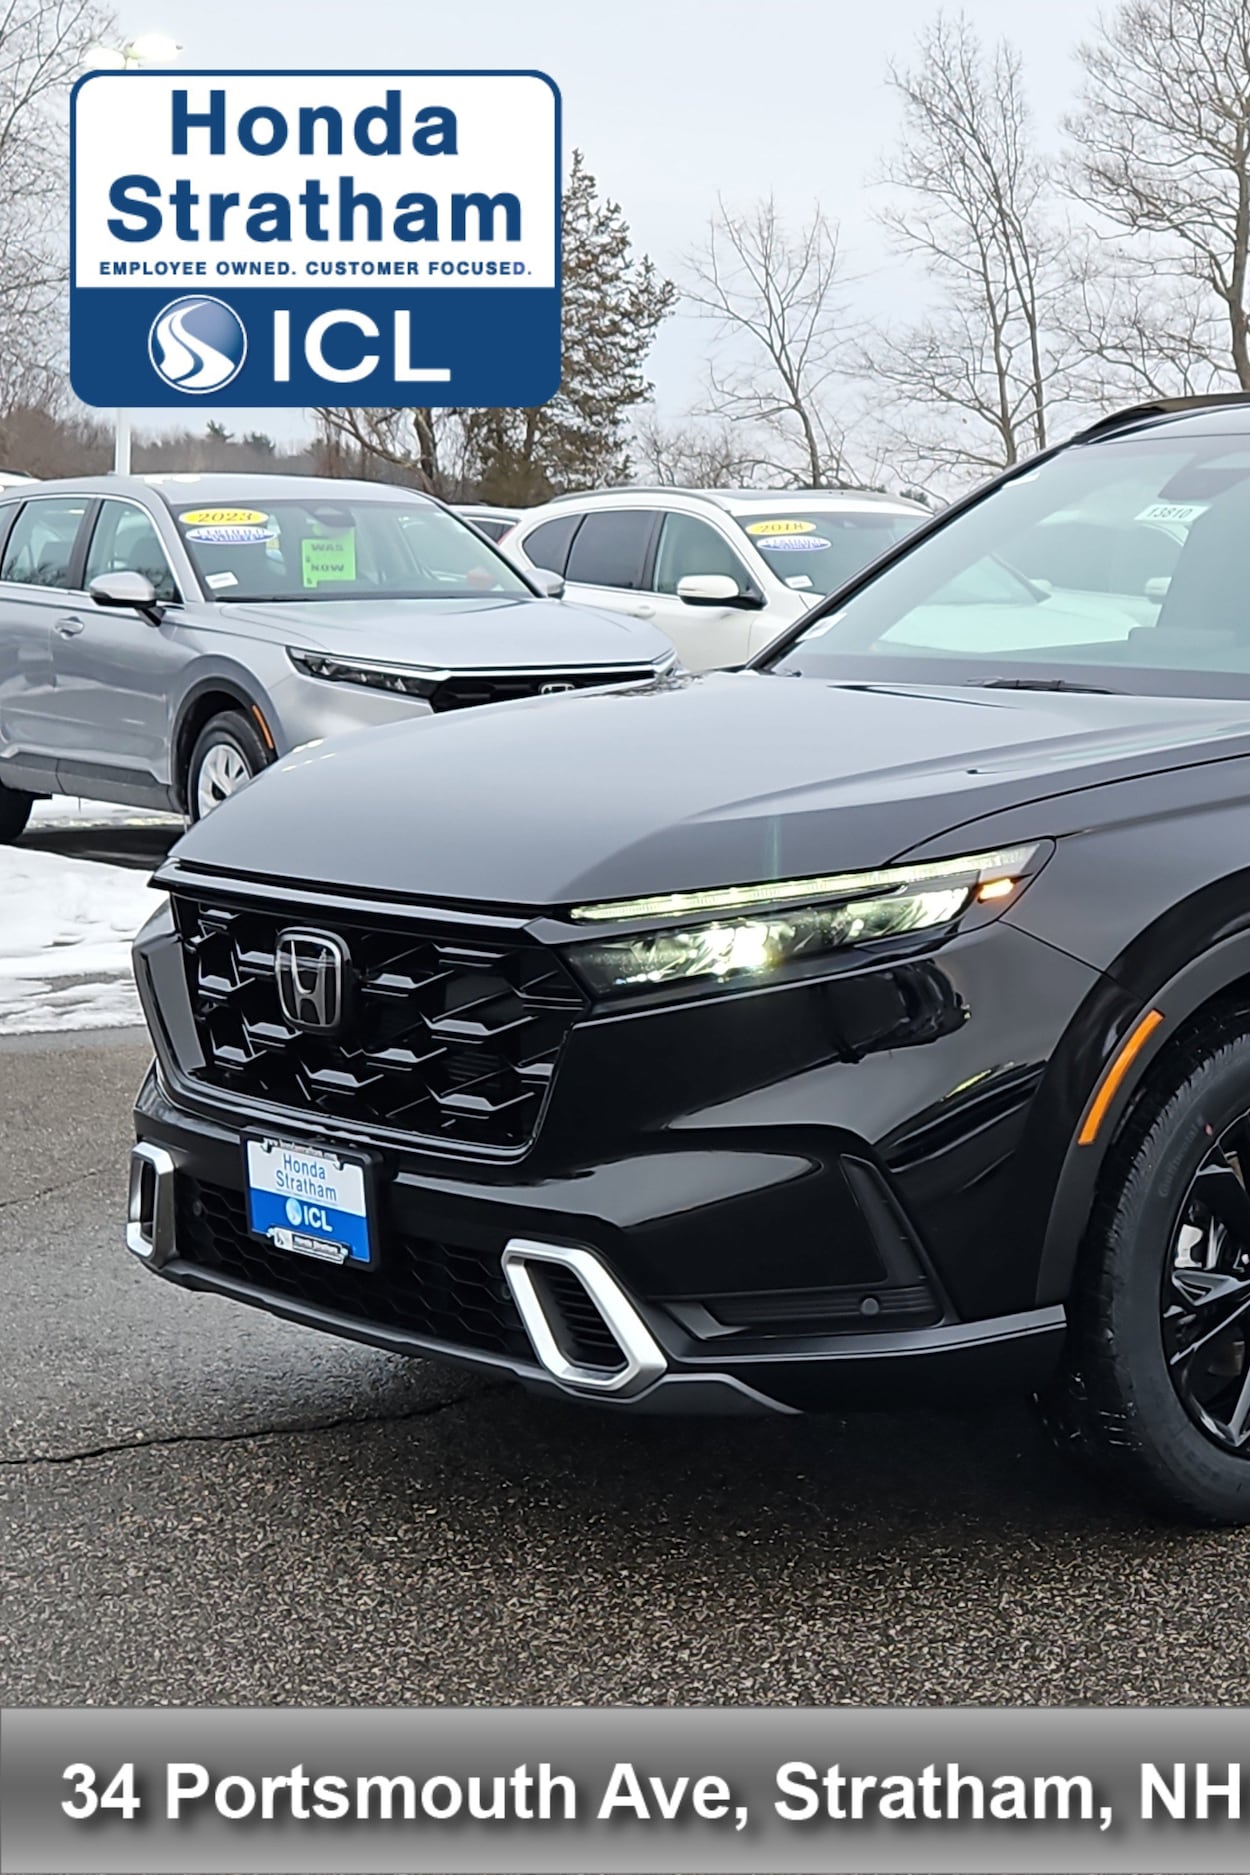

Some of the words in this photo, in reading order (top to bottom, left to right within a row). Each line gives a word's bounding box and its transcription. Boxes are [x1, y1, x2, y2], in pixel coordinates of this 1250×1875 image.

[197, 511, 254, 523] 2023
[283, 1152, 326, 1180] Honda
[276, 1169, 337, 1202] Stratham
[303, 1205, 334, 1232] ICL
